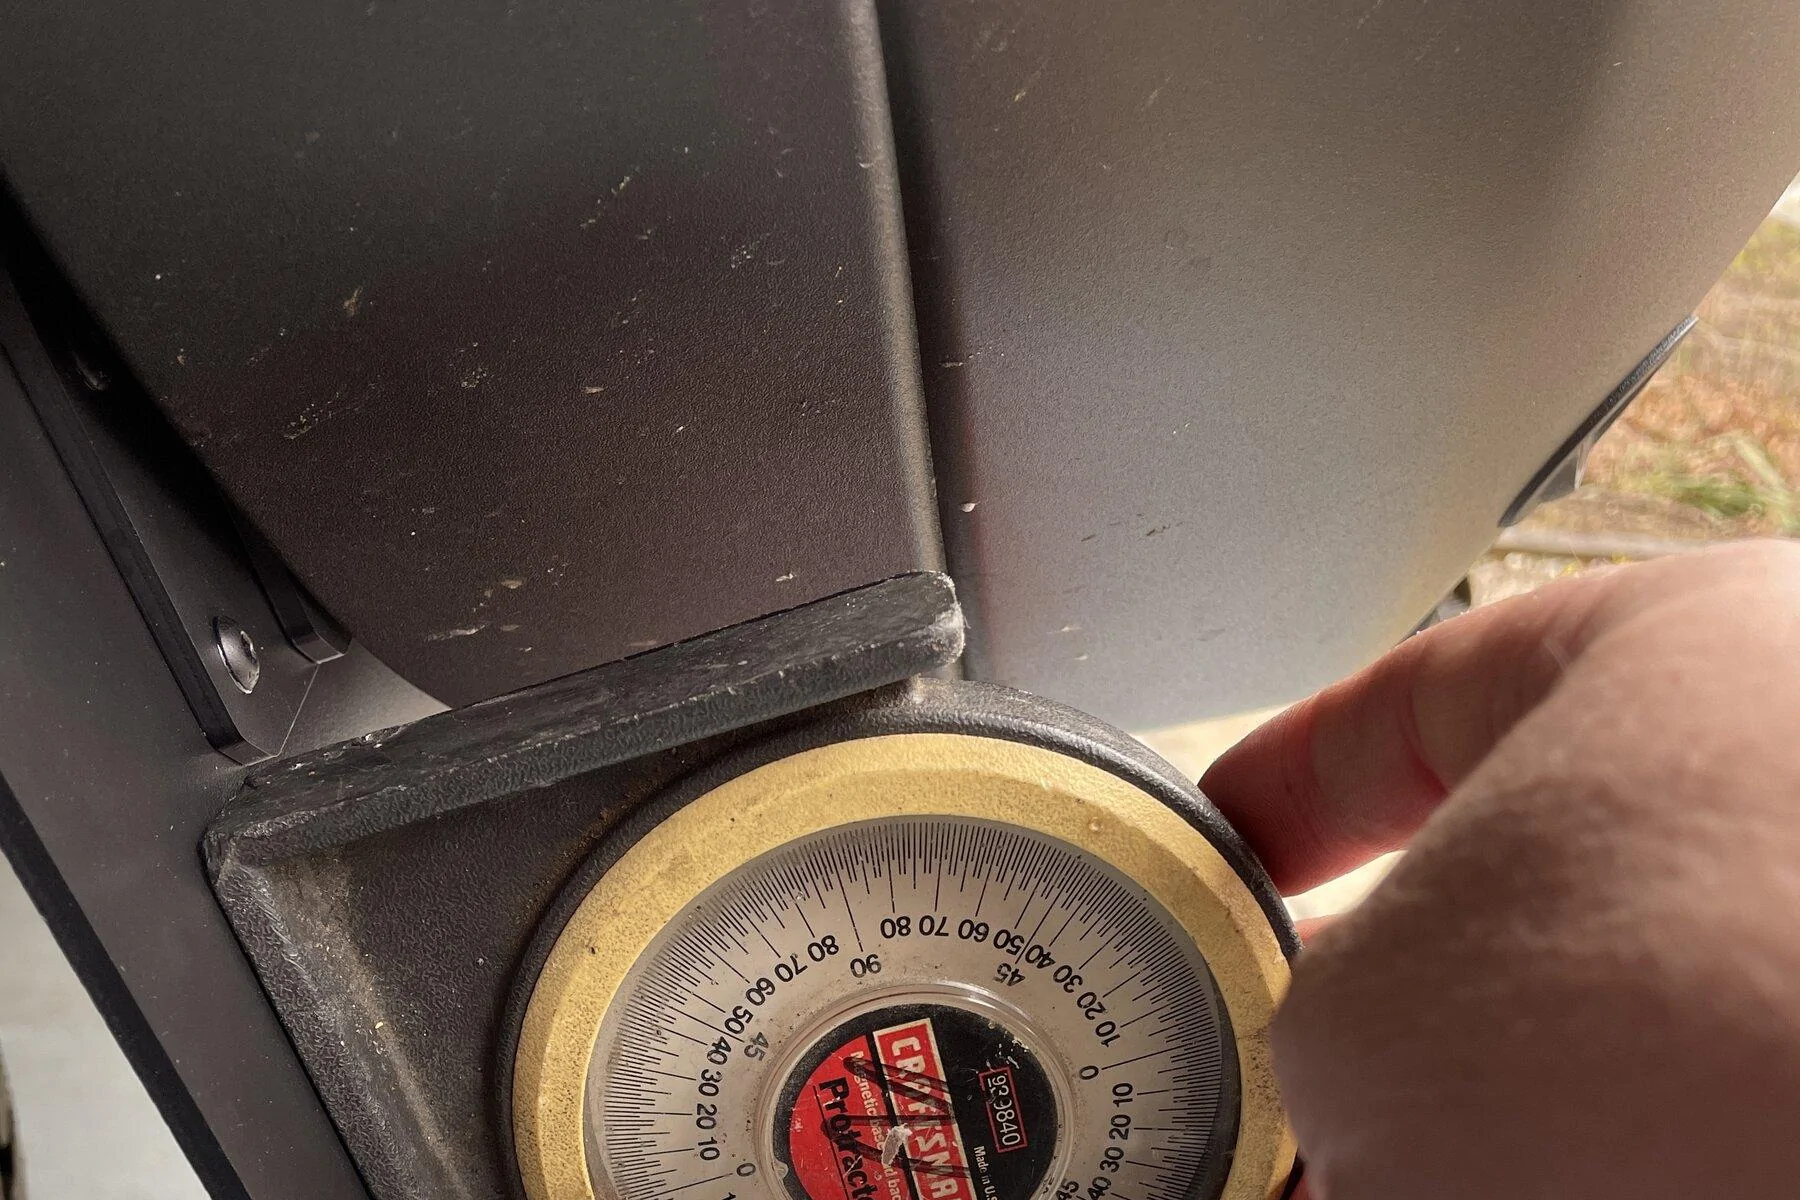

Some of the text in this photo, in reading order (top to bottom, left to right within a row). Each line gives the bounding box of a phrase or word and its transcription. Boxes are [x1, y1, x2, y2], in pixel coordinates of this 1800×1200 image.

[880, 914, 949, 939] 70 80
[957, 918, 990, 943] 60
[807, 935, 840, 962] 80
[993, 929, 1025, 956] 50
[774, 953, 808, 983] 70
[849, 953, 882, 978] 90
[1025, 944, 1056, 971] 40
[993, 962, 1026, 987] 45
[1052, 964, 1084, 994] 30
[745, 977, 776, 1006] 60
[1076, 991, 1108, 1021] 20
[724, 1005, 754, 1035] 50
[1095, 1020, 1121, 1047] 10
[706, 1036, 732, 1065] 40
[744, 1031, 770, 1061] 45
[698, 1068, 723, 1097] 30
[1079, 1065, 1100, 1081] 0
[1112, 1082, 1134, 1108] 10
[695, 1103, 718, 1130] 20
[1108, 1114, 1132, 1141] 20
[697, 1136, 721, 1161] 10
[974, 1145, 989, 1172] Made
[1100, 1146, 1125, 1173] 30
[736, 1162, 757, 1178] 0
